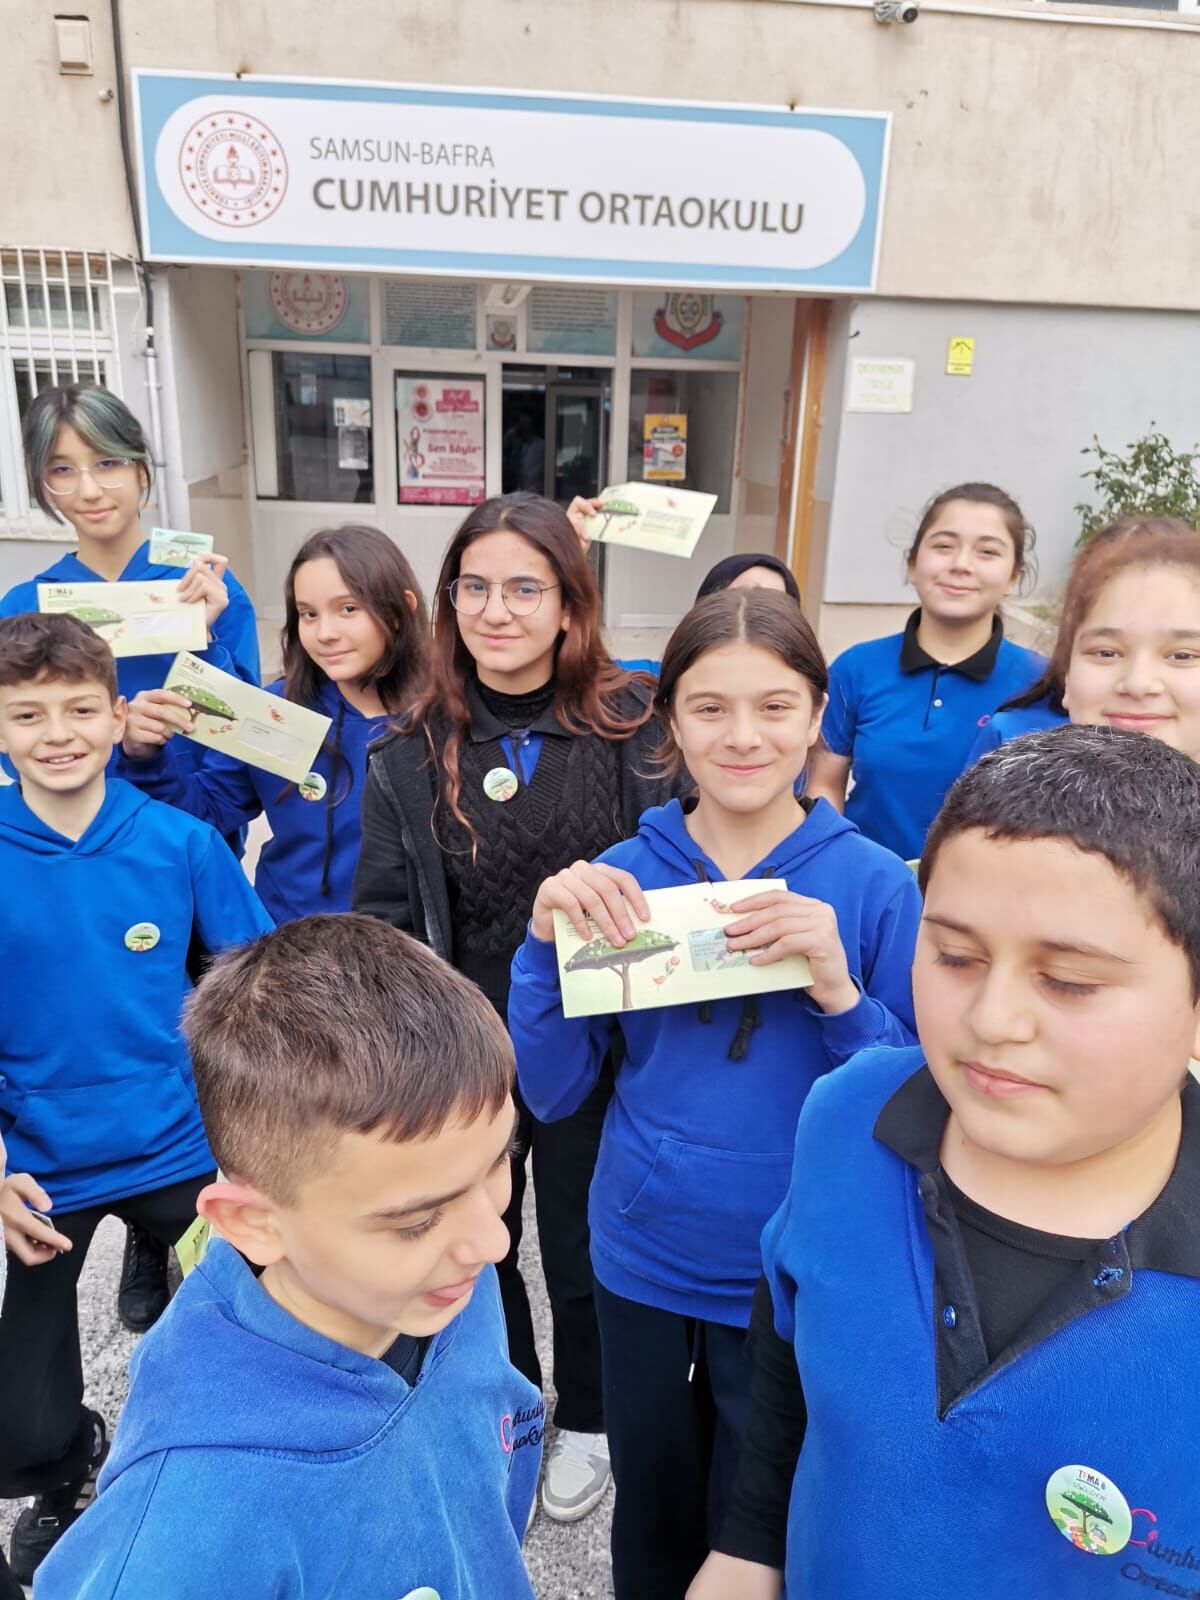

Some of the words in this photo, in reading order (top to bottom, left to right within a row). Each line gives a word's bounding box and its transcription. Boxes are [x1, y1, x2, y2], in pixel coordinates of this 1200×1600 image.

[309, 136, 496, 169] SAMSUN-BAFRA
[312, 177, 568, 222] CUMHURİYET
[579, 190, 804, 235] ORTAOKULU
